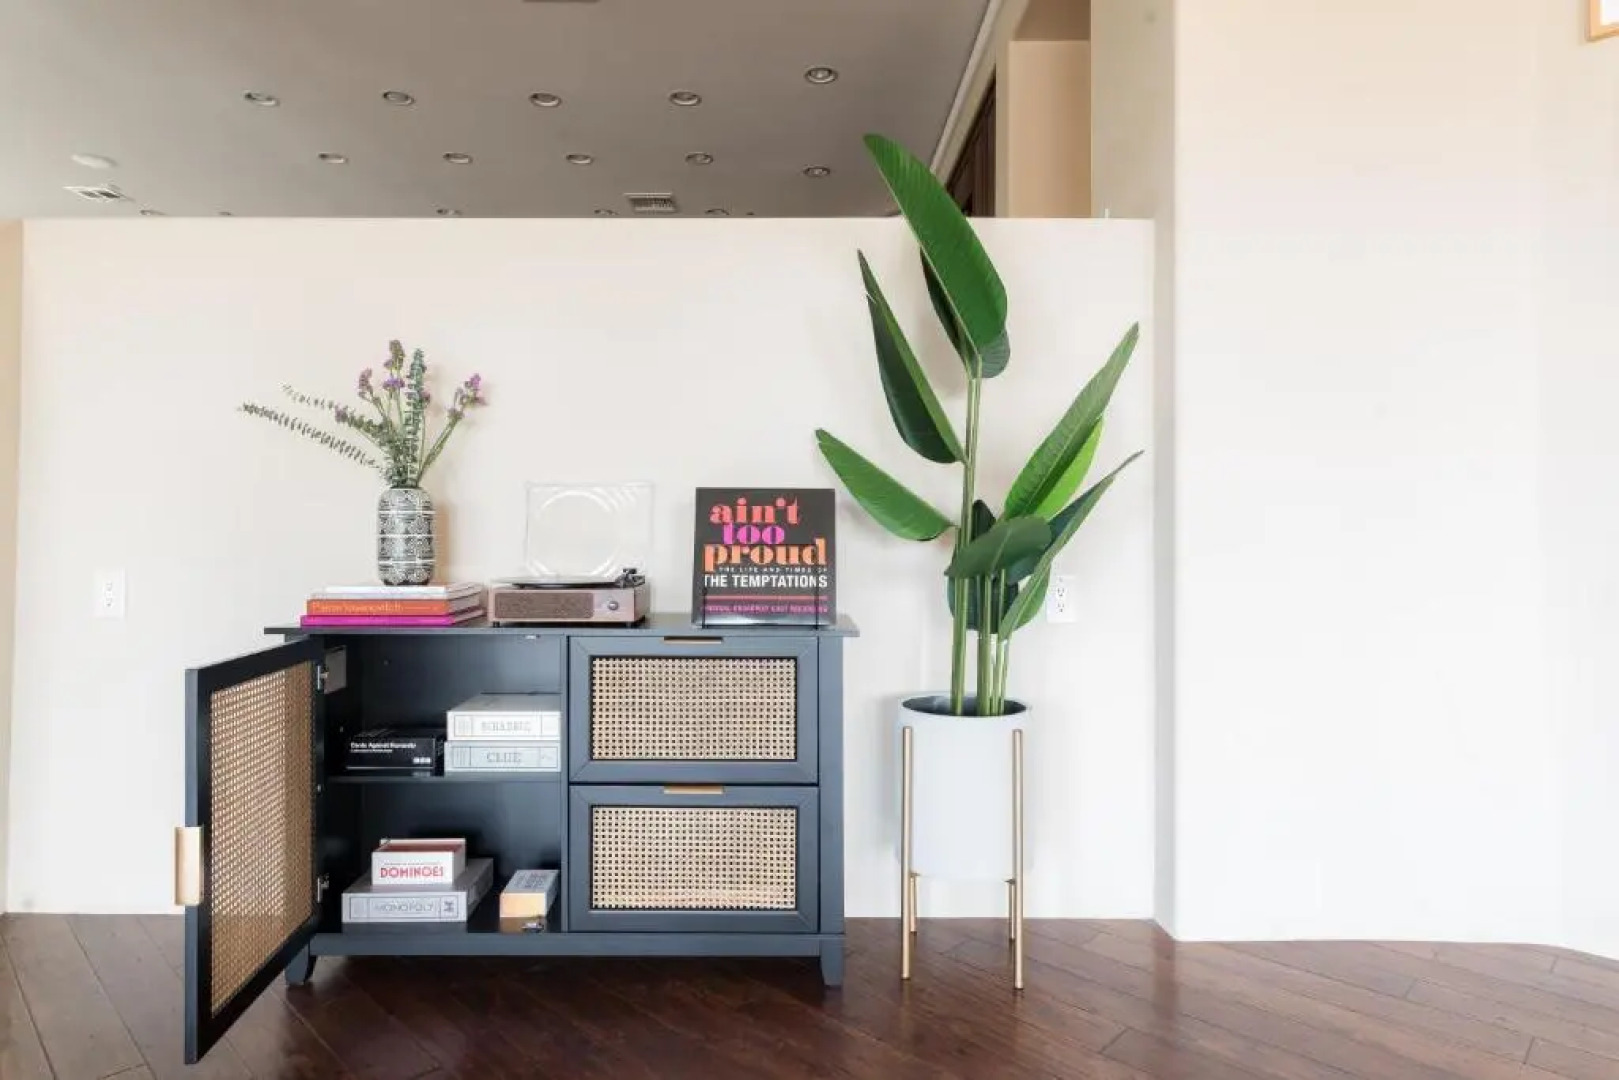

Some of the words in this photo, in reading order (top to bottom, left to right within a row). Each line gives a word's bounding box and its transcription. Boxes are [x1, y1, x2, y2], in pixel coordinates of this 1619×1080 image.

[709, 497, 798, 525] ain't
[723, 523, 785, 545] too
[704, 538, 827, 572] proud
[704, 574, 728, 588] THE
[732, 574, 828, 588] TEMPTATIONS
[380, 866, 443, 879] DOMINOES
